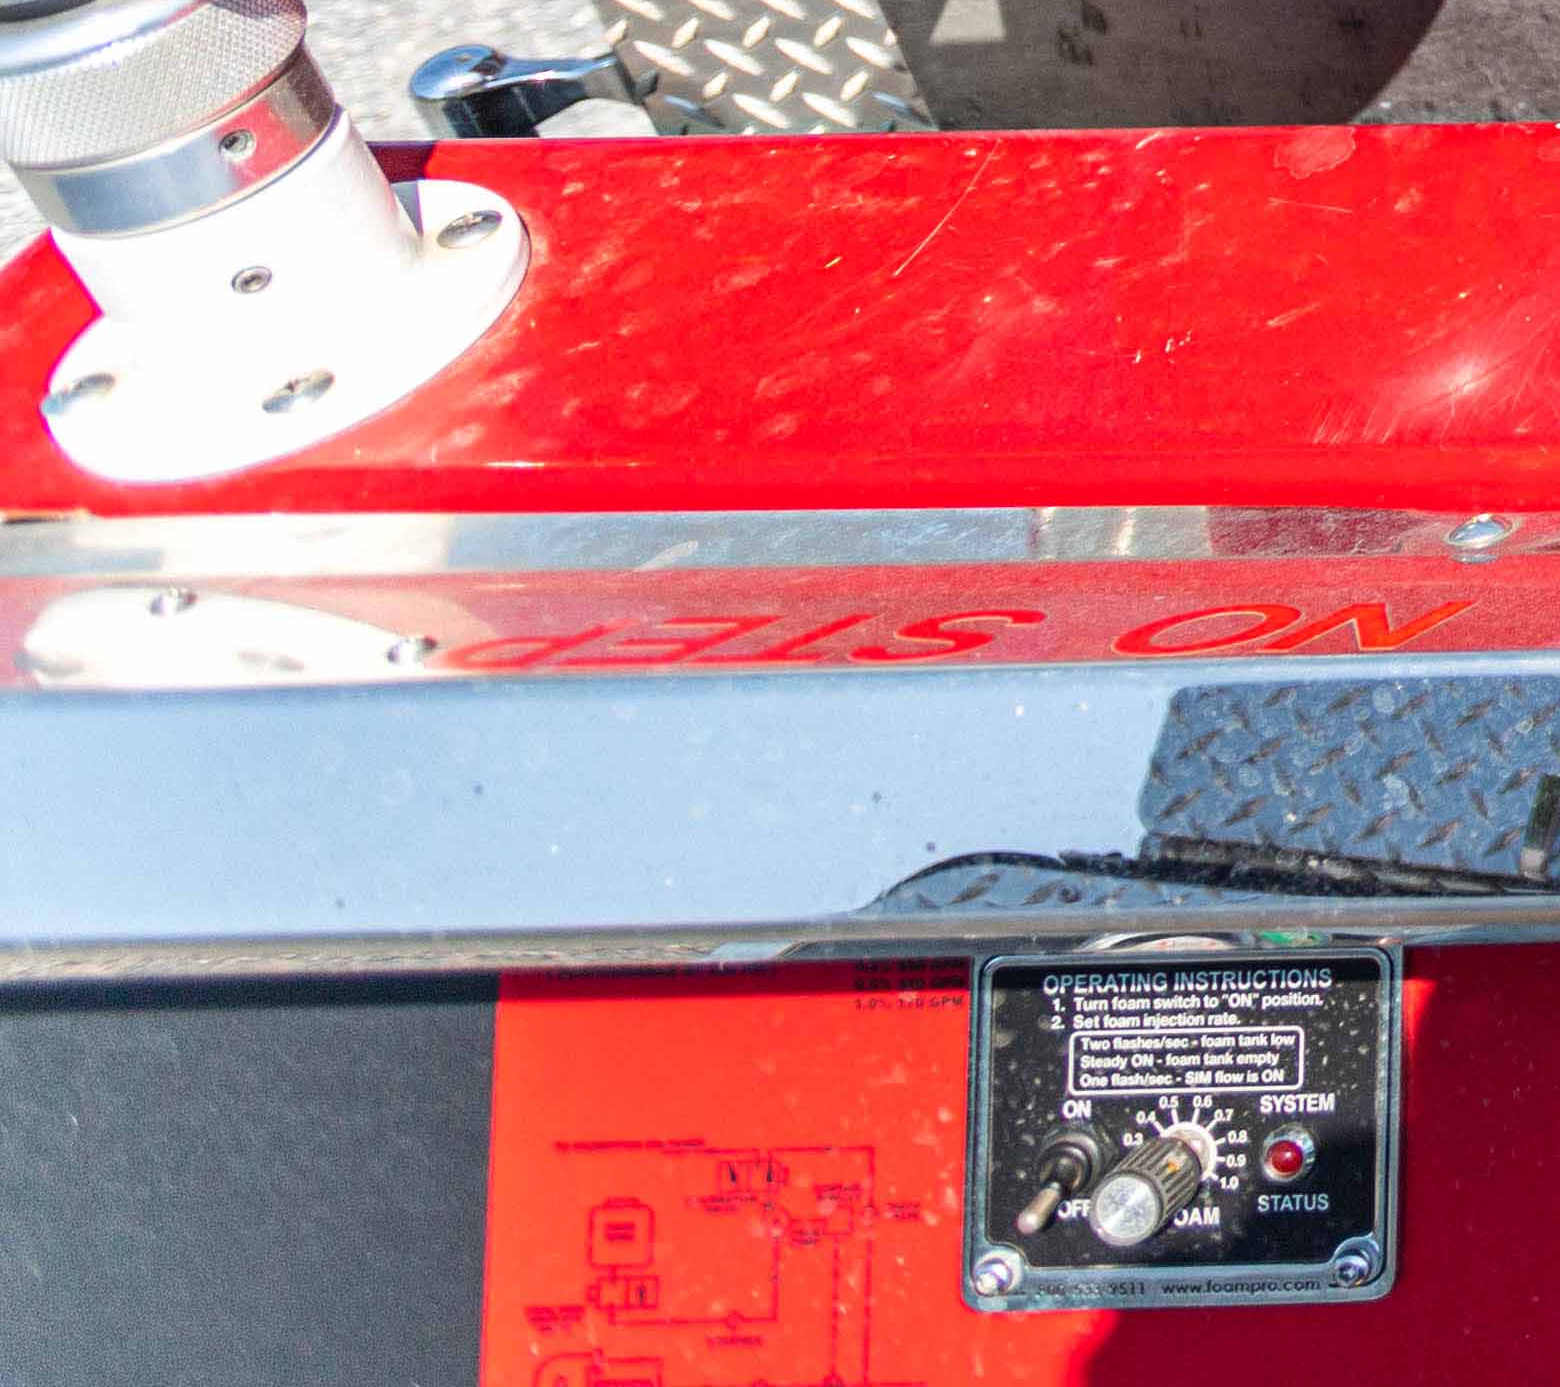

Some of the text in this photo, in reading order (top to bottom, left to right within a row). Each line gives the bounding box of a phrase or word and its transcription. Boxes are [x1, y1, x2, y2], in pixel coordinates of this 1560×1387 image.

[449, 601, 1476, 670] NO STEP
[1043, 968, 1333, 995] OPERATING INSTRUCTIONS
[1052, 998, 1066, 1012] 1.
[1073, 997, 1109, 1011] Turn
[1112, 995, 1150, 1010] foam
[1153, 994, 1201, 1009] switch
[1203, 995, 1218, 1008] to
[1262, 992, 1323, 1009] position.
[1051, 1012, 1241, 1030] 2. Set foam injection rate.
[1081, 1037, 1110, 1051] Two
[1113, 1035, 1189, 1050] flashes/sec
[1201, 1034, 1235, 1048] foam
[1238, 1032, 1268, 1047] tank
[1270, 1032, 1295, 1046] low
[1080, 1054, 1127, 1070] Steady
[1131, 1053, 1155, 1067] ON
[1166, 1052, 1200, 1066] foam
[1203, 1050, 1233, 1065] tank
[1237, 1051, 1280, 1068] empty
[1080, 1074, 1108, 1087] One
[1111, 1072, 1173, 1087] flash/sec
[1185, 1071, 1211, 1085] SIM
[1214, 1070, 1244, 1084] flow
[1247, 1070, 1259, 1083] is
[1261, 1069, 1284, 1082] ON
[1062, 1100, 1092, 1119] ON
[1159, 1096, 1179, 1109] 0.5
[1192, 1095, 1213, 1108] 0.6
[1259, 1093, 1336, 1114] SYSTEM
[1136, 1110, 1156, 1124] 0.4
[1214, 1109, 1234, 1122] 0.7
[1123, 1132, 1143, 1146] 0.3
[1228, 1130, 1248, 1143] 0.8
[1226, 1154, 1247, 1167] 0.9
[1220, 1176, 1239, 1189] 1.0
[1058, 1199, 1092, 1219] OFF
[1257, 1194, 1330, 1212] STATUS
[1174, 1207, 1220, 1226] OAM
[1162, 1279, 1321, 1295] www.foampro.com
